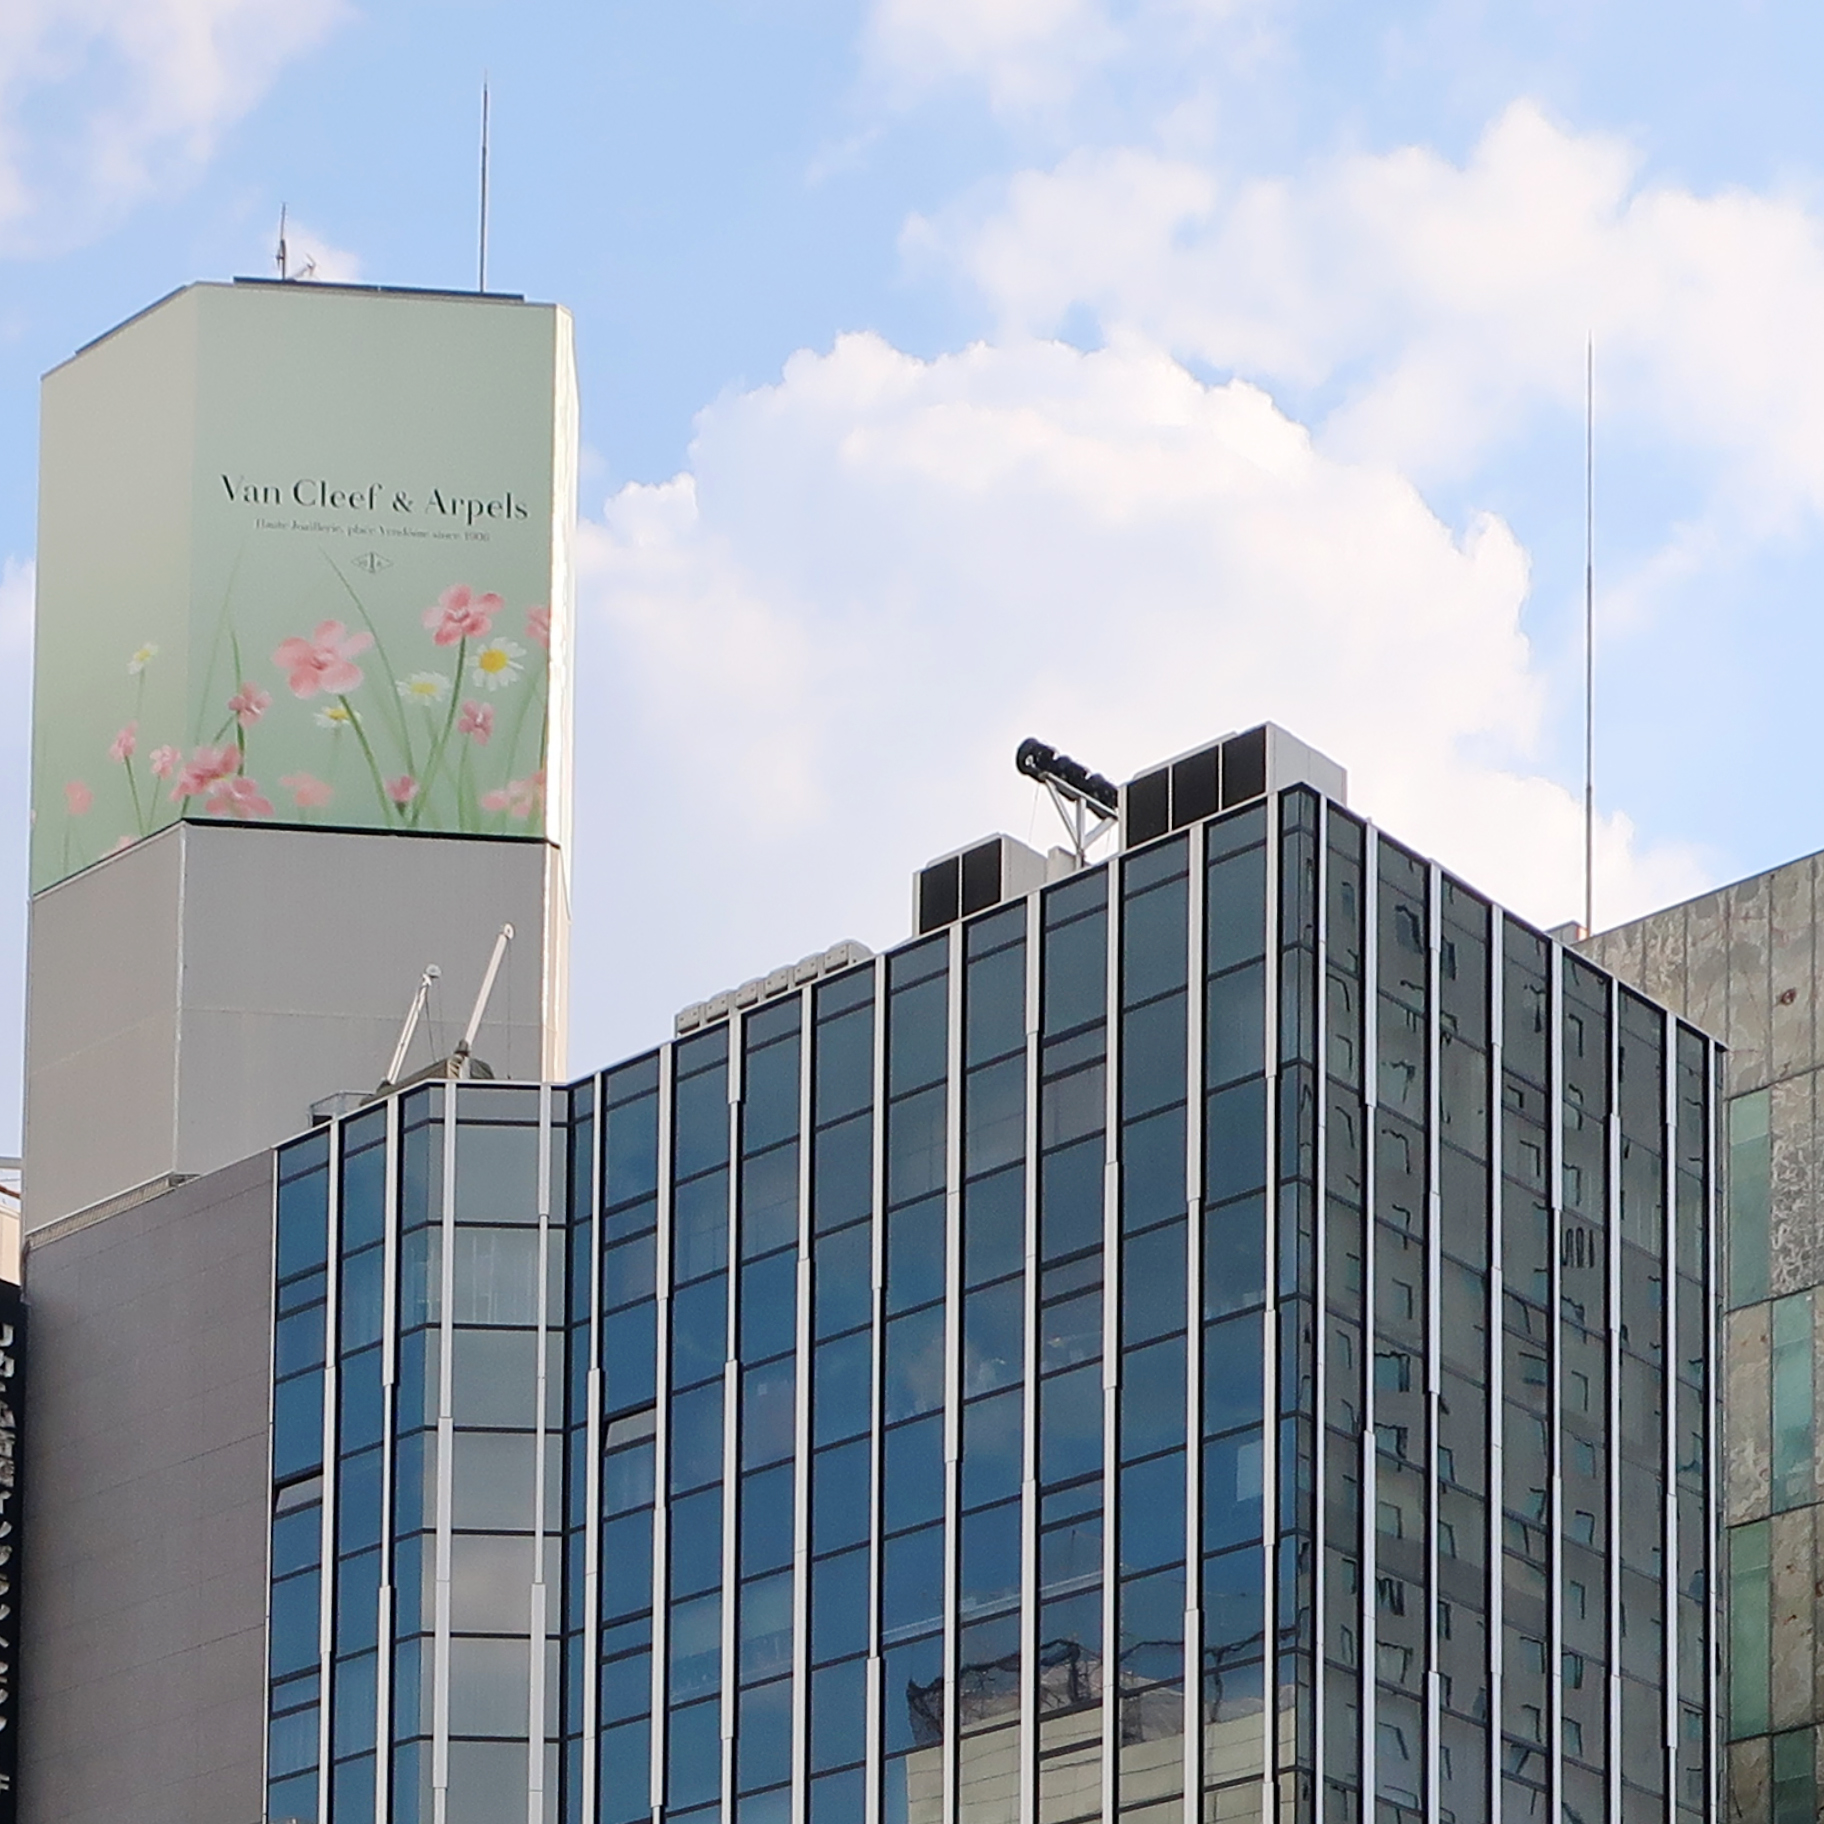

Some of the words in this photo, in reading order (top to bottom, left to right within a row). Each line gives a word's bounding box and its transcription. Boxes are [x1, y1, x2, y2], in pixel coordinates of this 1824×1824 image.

[221, 474, 281, 504] Van
[293, 478, 383, 511] Cleef
[392, 490, 414, 513] &
[426, 487, 529, 526] Arpels
